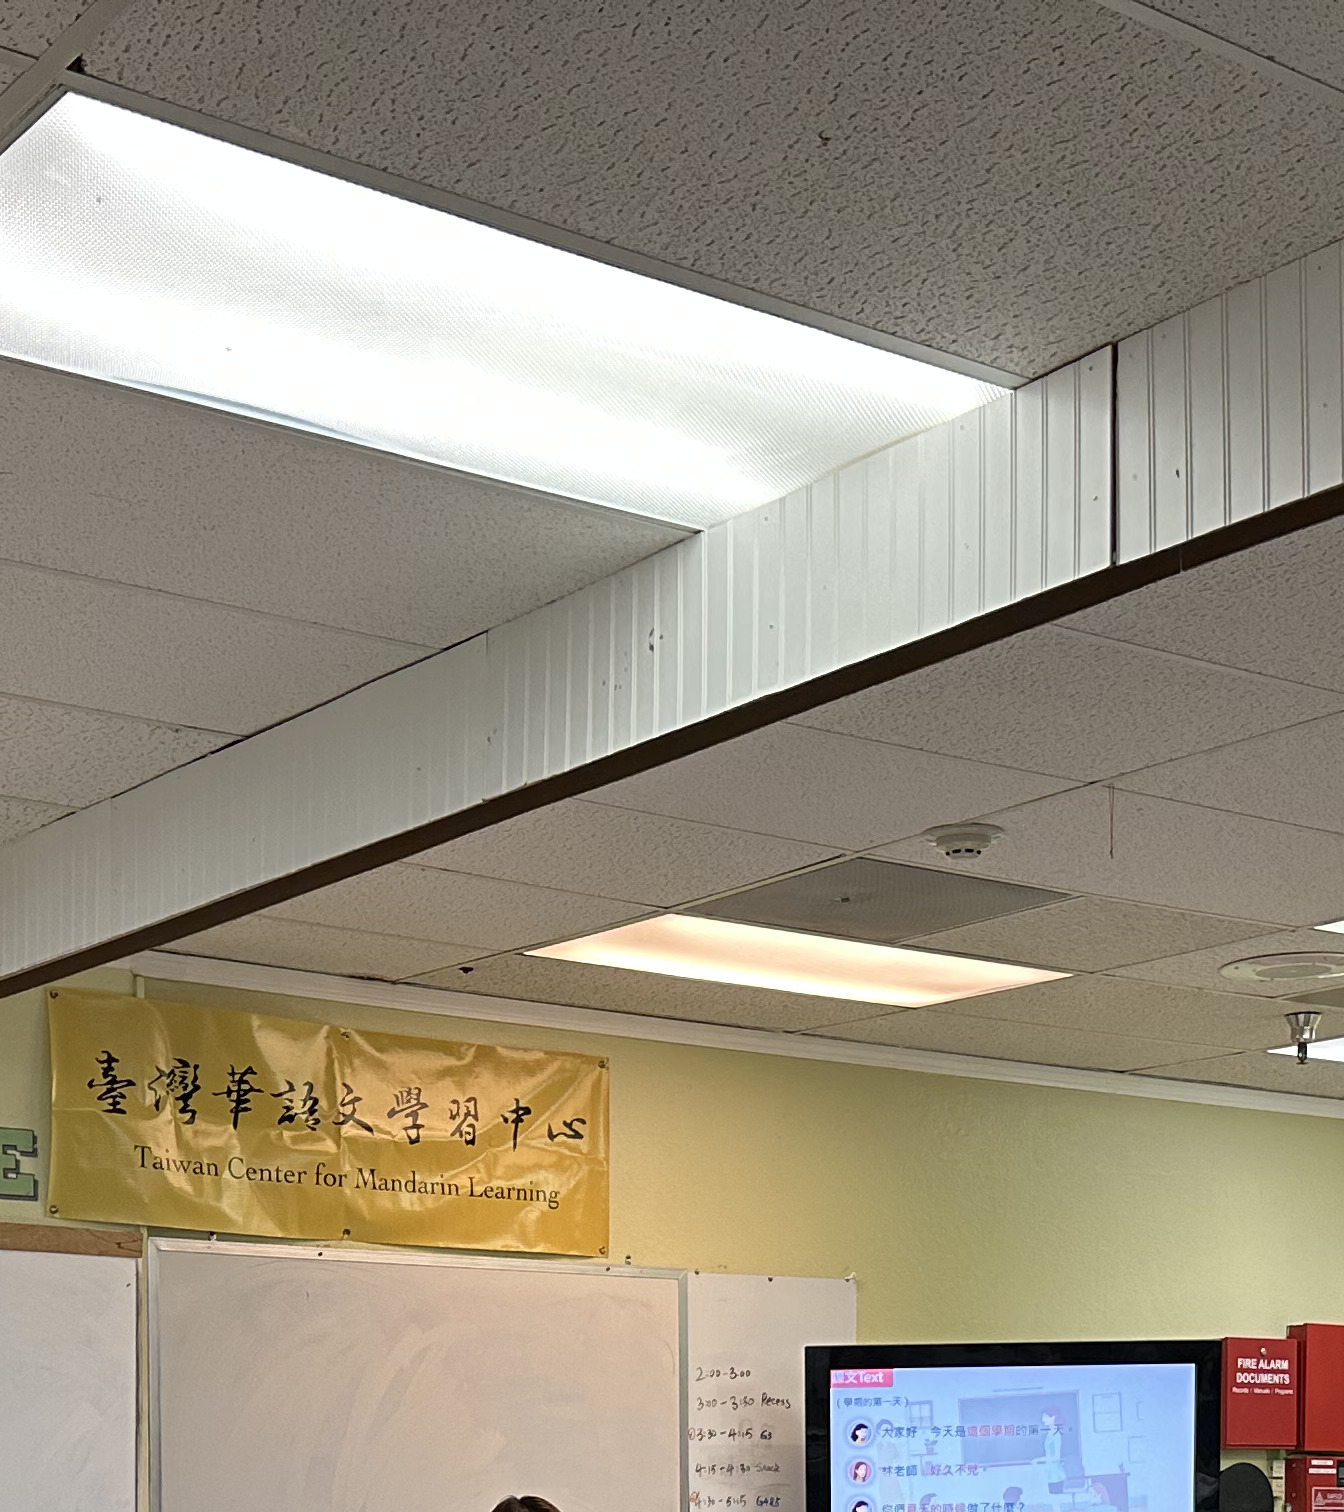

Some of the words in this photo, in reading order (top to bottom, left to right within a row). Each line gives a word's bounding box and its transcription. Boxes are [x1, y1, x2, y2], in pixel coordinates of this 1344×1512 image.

[86, 1050, 587, 1151] 臺灣華語文學習中心
[133, 1144, 219, 1178] Taiwan
[228, 1157, 308, 1187] Center
[314, 1162, 348, 1190] for
[355, 1167, 460, 1198] Mandarin
[468, 1176, 560, 1210] Learning
[1236, 1372, 1290, 1385] DOCUMENTS
[1237, 1357, 1258, 1369] FIRE
[1258, 1358, 1289, 1370] ALARM
